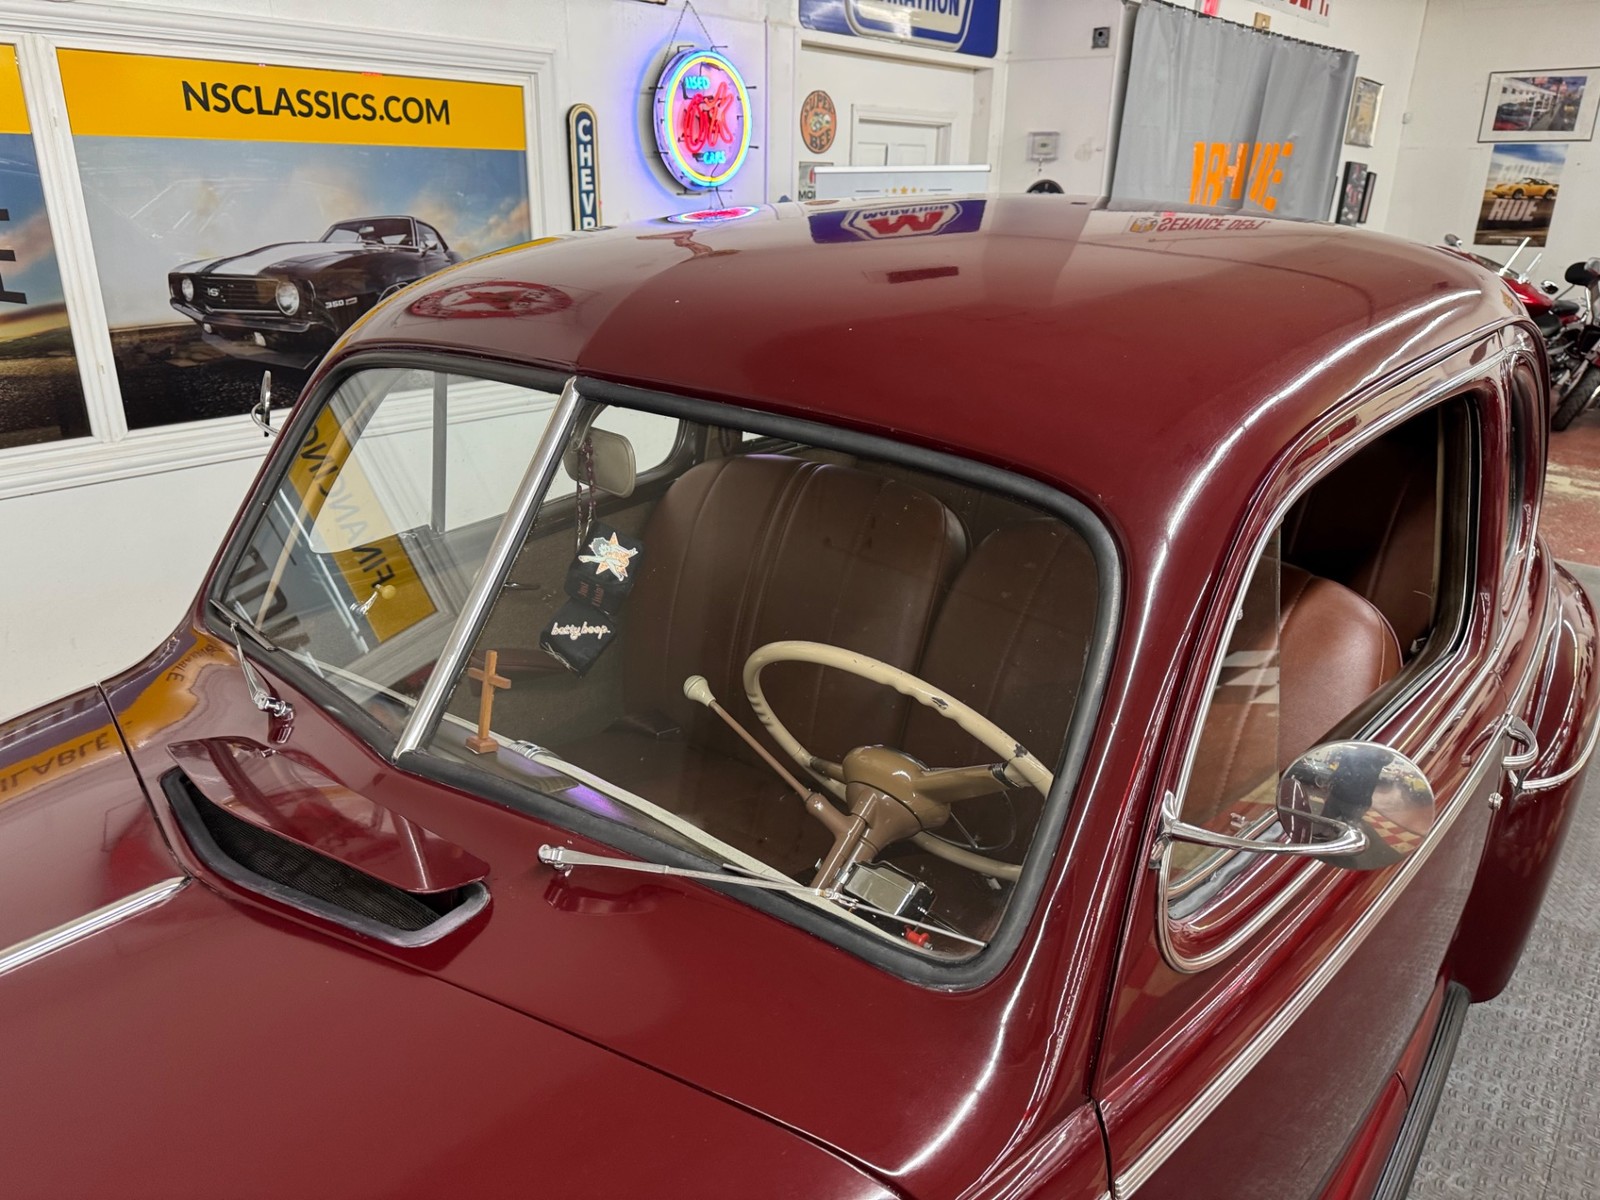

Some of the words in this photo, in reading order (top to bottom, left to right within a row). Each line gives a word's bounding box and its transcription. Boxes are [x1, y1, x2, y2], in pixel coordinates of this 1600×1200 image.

[685, 76, 710, 89] USED
[181, 80, 451, 125] NSCLASSICS.COM
[804, 94, 835, 124] SUPER
[684, 83, 734, 154] OK
[809, 128, 831, 151] BEE
[702, 151, 726, 164] CARS
[1488, 198, 1538, 221] RIDE
